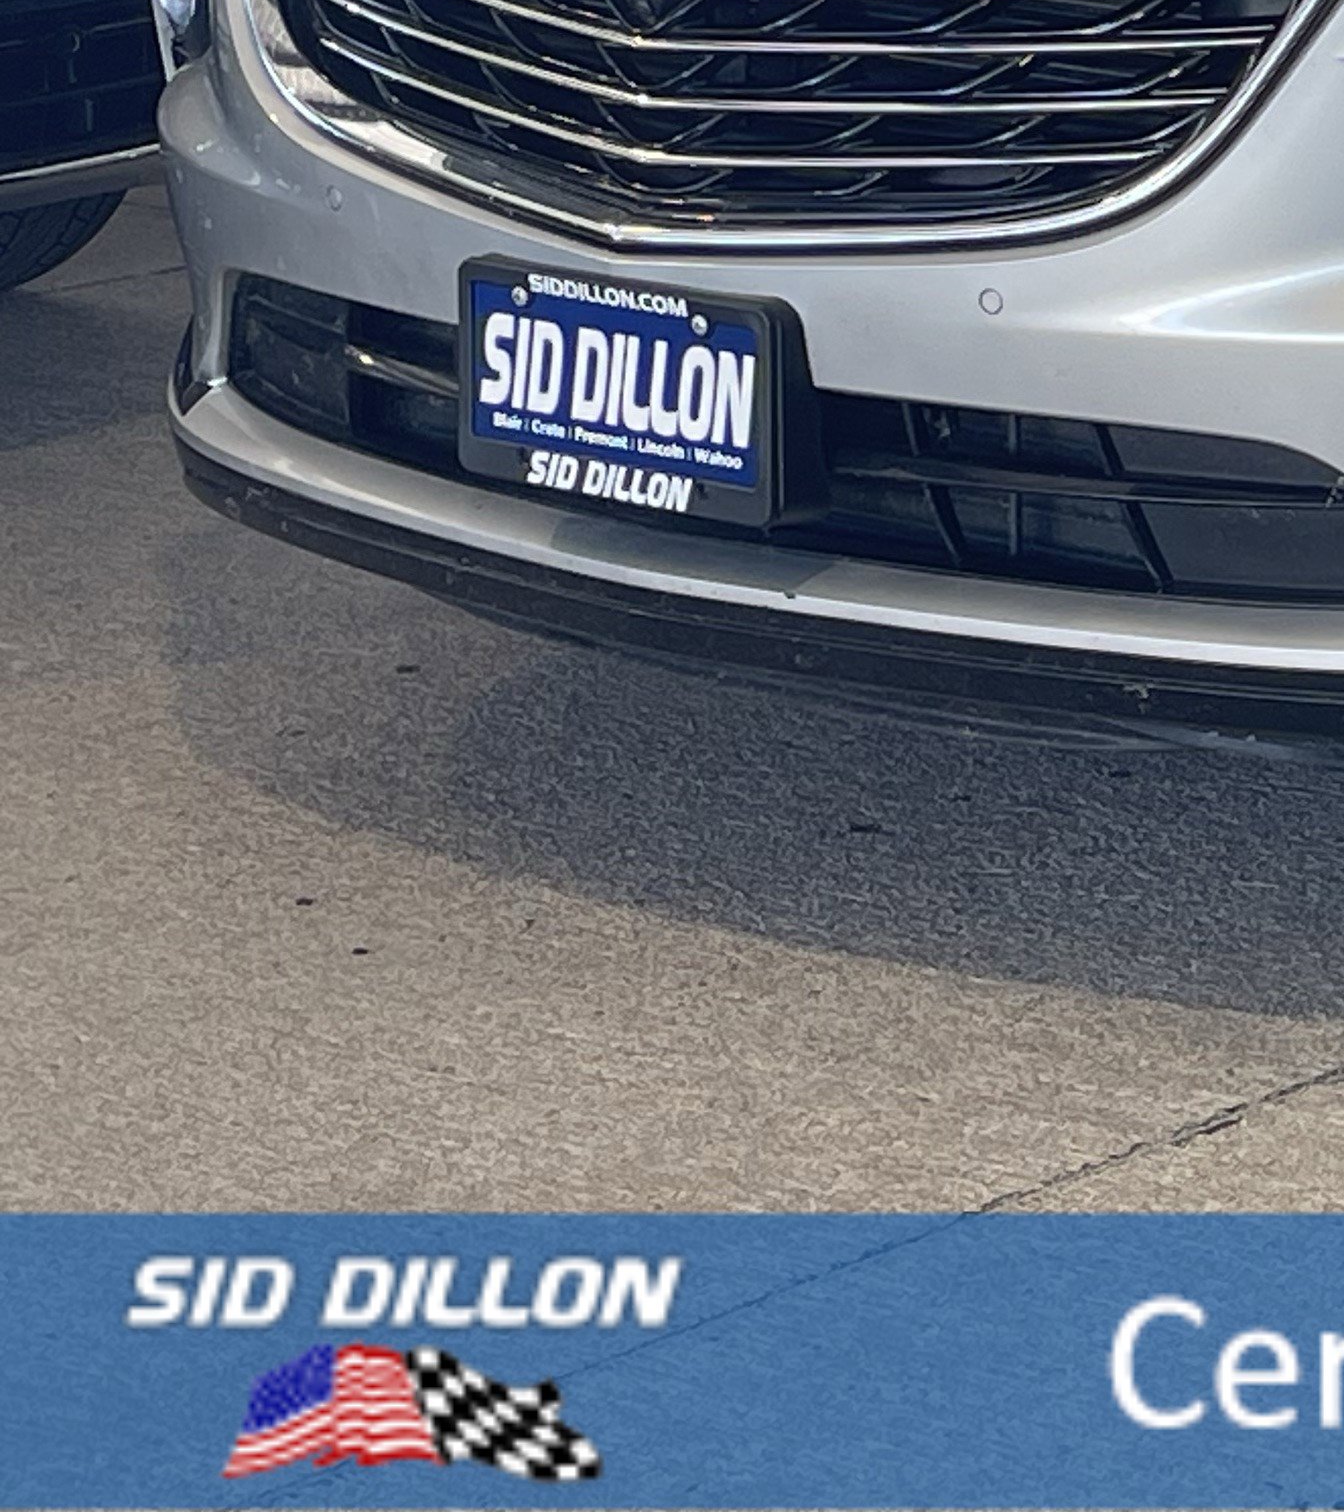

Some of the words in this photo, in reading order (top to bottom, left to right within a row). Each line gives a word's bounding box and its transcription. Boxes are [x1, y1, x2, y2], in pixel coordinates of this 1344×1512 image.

[527, 274, 689, 318] SIDDILLON.COM
[480, 312, 564, 415] SID
[570, 326, 756, 449] DILLON
[637, 438, 685, 460] Lincoln
[694, 448, 743, 470] Wahoo
[527, 450, 579, 491] SID
[582, 464, 693, 512] DILLON
